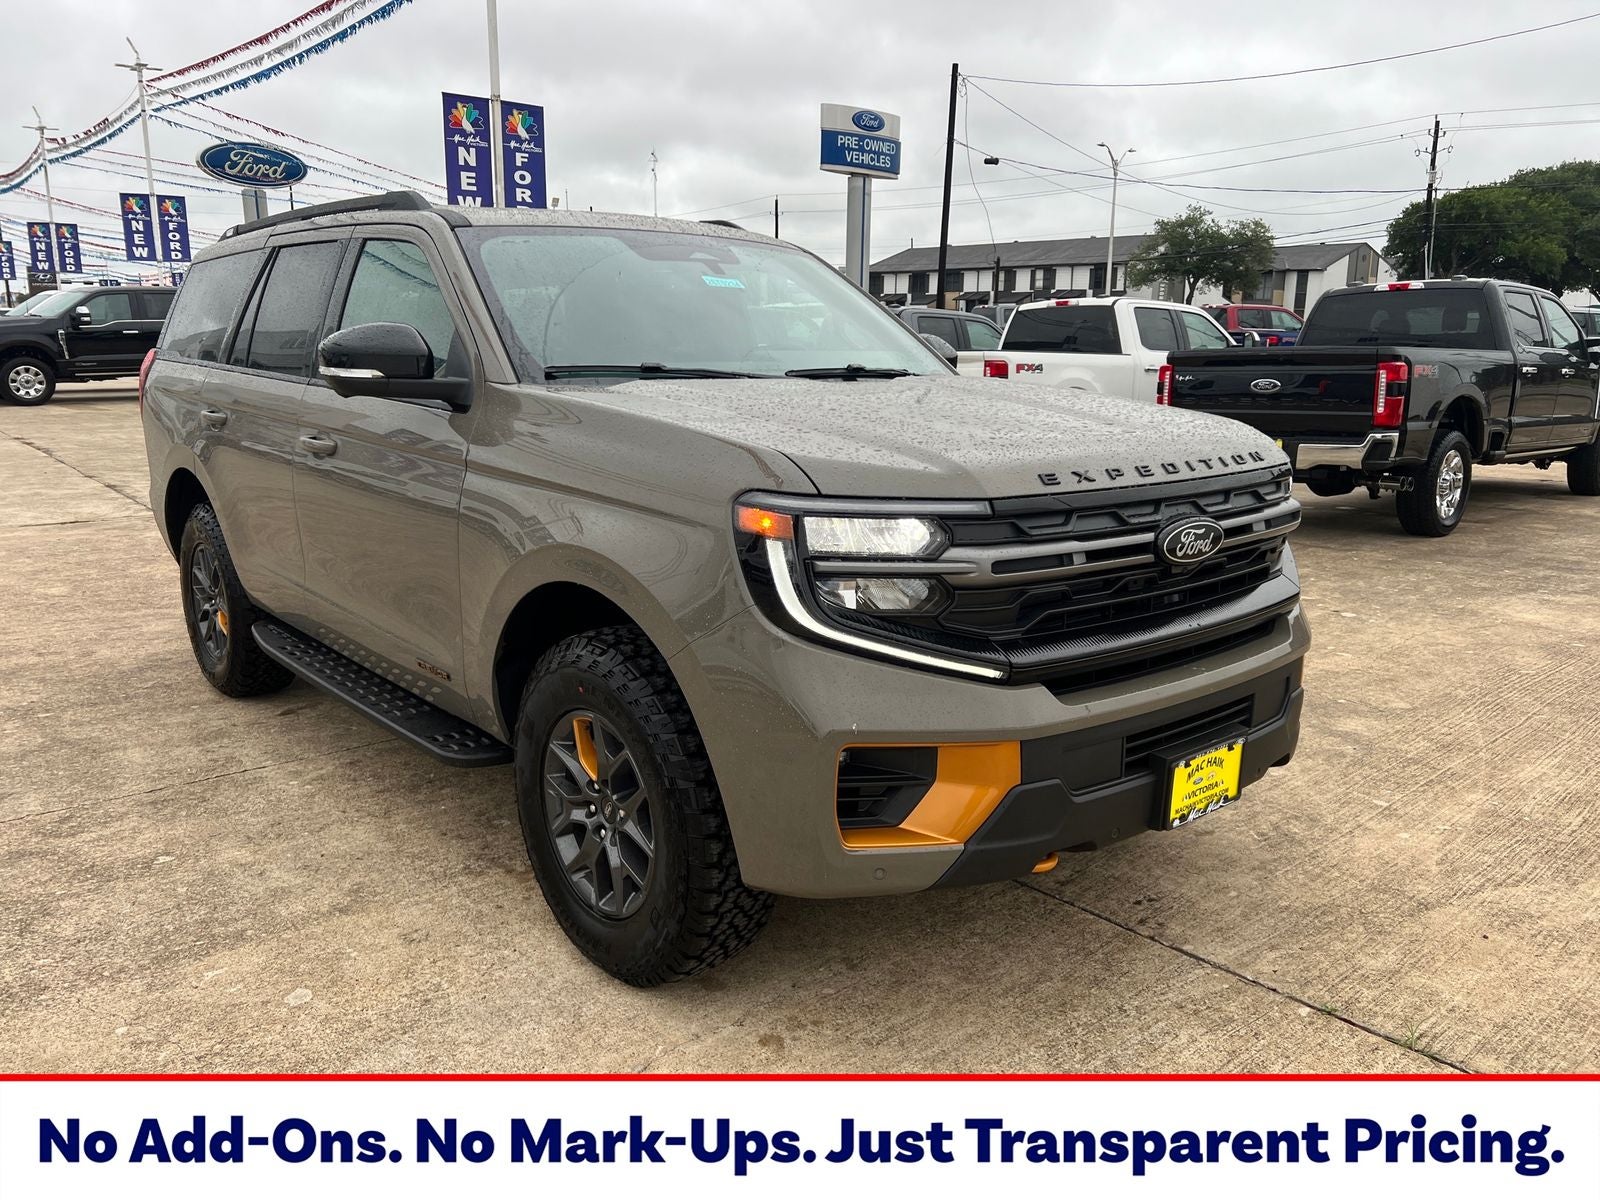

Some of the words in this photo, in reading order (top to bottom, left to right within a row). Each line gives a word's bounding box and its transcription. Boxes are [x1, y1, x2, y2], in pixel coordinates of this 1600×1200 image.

[860, 113, 880, 128] Ford
[837, 135, 896, 154] PRE-OWNED
[224, 149, 286, 179] Ford
[845, 150, 891, 168] VEHICLES
[457, 146, 482, 208] NEW
[514, 152, 533, 209] FOR
[131, 220, 148, 258] NEW
[168, 222, 182, 260] FORD
[1, 256, 11, 279] FORD
[35, 242, 49, 270] NEW
[64, 243, 76, 271] FORD
[1015, 363, 1043, 374] FX4
[1256, 381, 1274, 390] Ford
[1038, 451, 1265, 486] EXPEDITION
[1176, 528, 1214, 557] Ford
[1186, 759, 1206, 783] MAC
[1206, 756, 1225, 769] HAIK
[1187, 782, 1219, 801] VICTORIA
